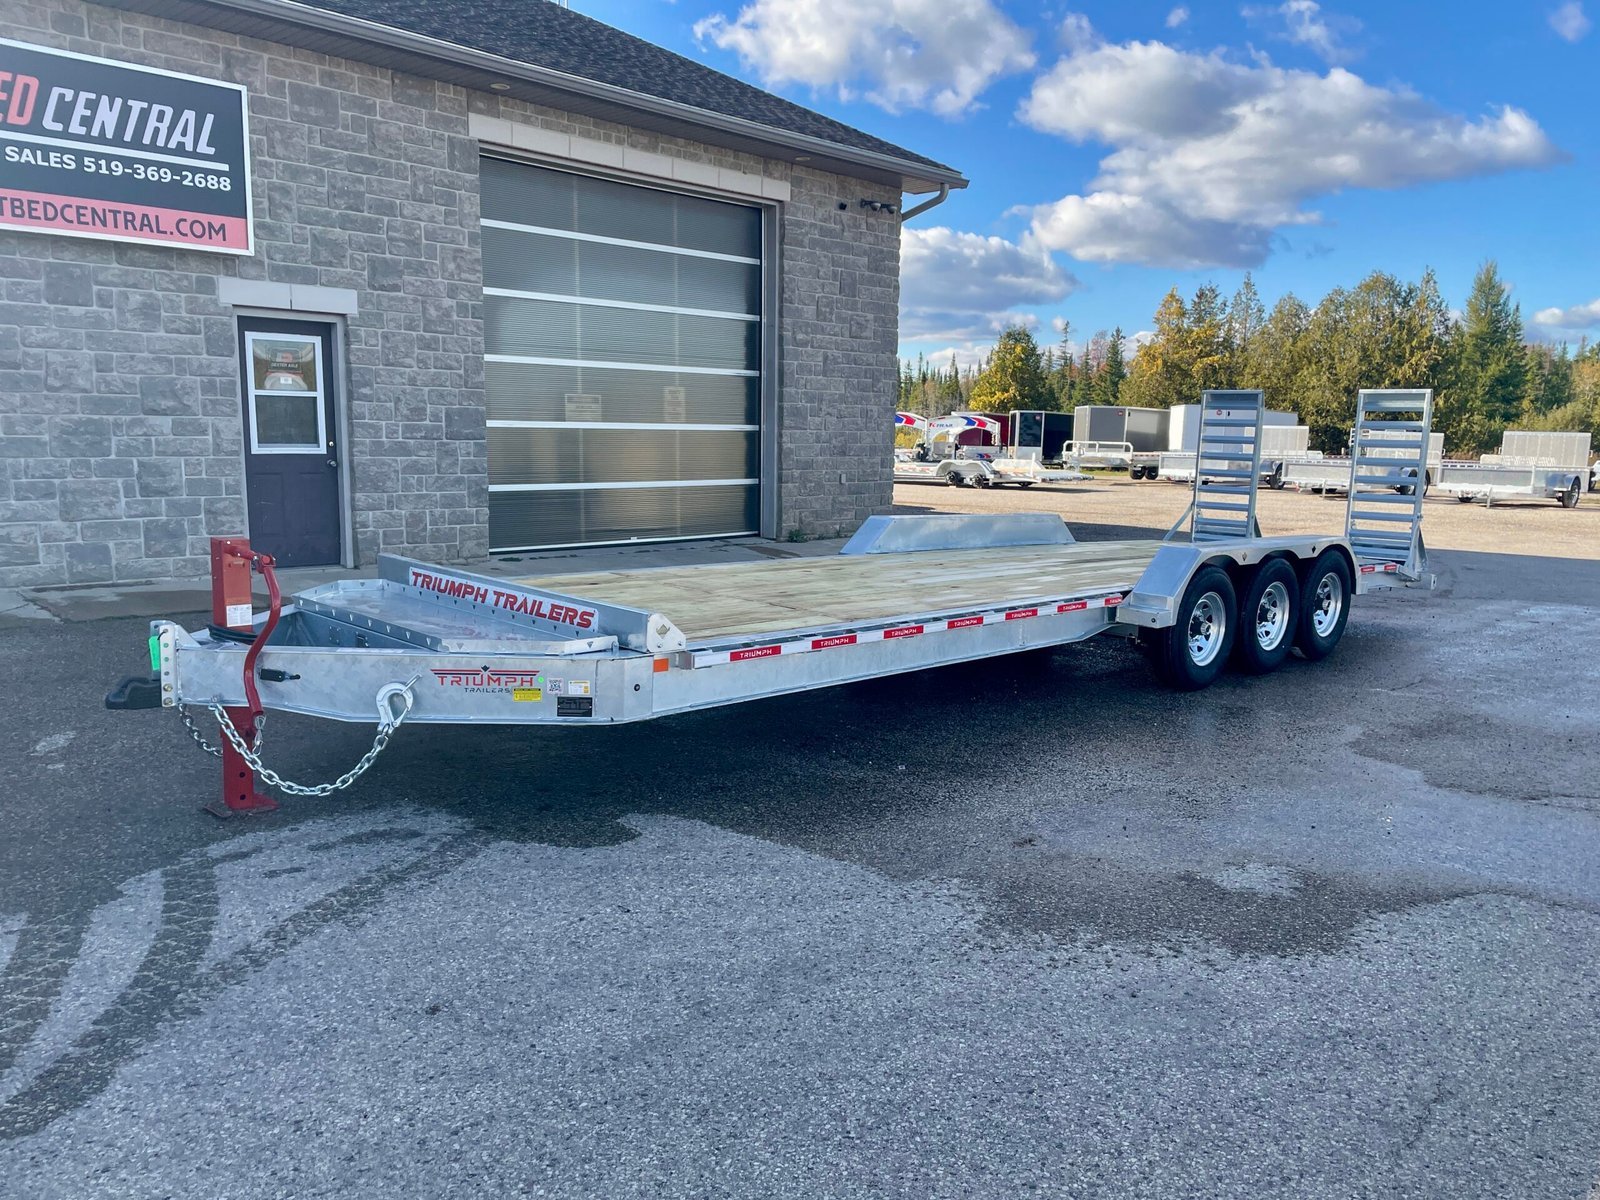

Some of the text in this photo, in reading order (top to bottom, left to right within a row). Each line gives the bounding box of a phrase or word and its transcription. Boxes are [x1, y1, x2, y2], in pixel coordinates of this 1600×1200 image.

[42, 86, 216, 155] CENTRAL
[5, 146, 231, 191] SALES 519-369-2688
[412, 571, 595, 629] TRIUMPH TRAILERS
[954, 619, 978, 627] TRIUMPH
[891, 628, 917, 636] TRIUMPH
[820, 637, 850, 647] TRIUMPH
[739, 648, 773, 659] TRIUMPH
[437, 674, 534, 687] TRIUMPH
